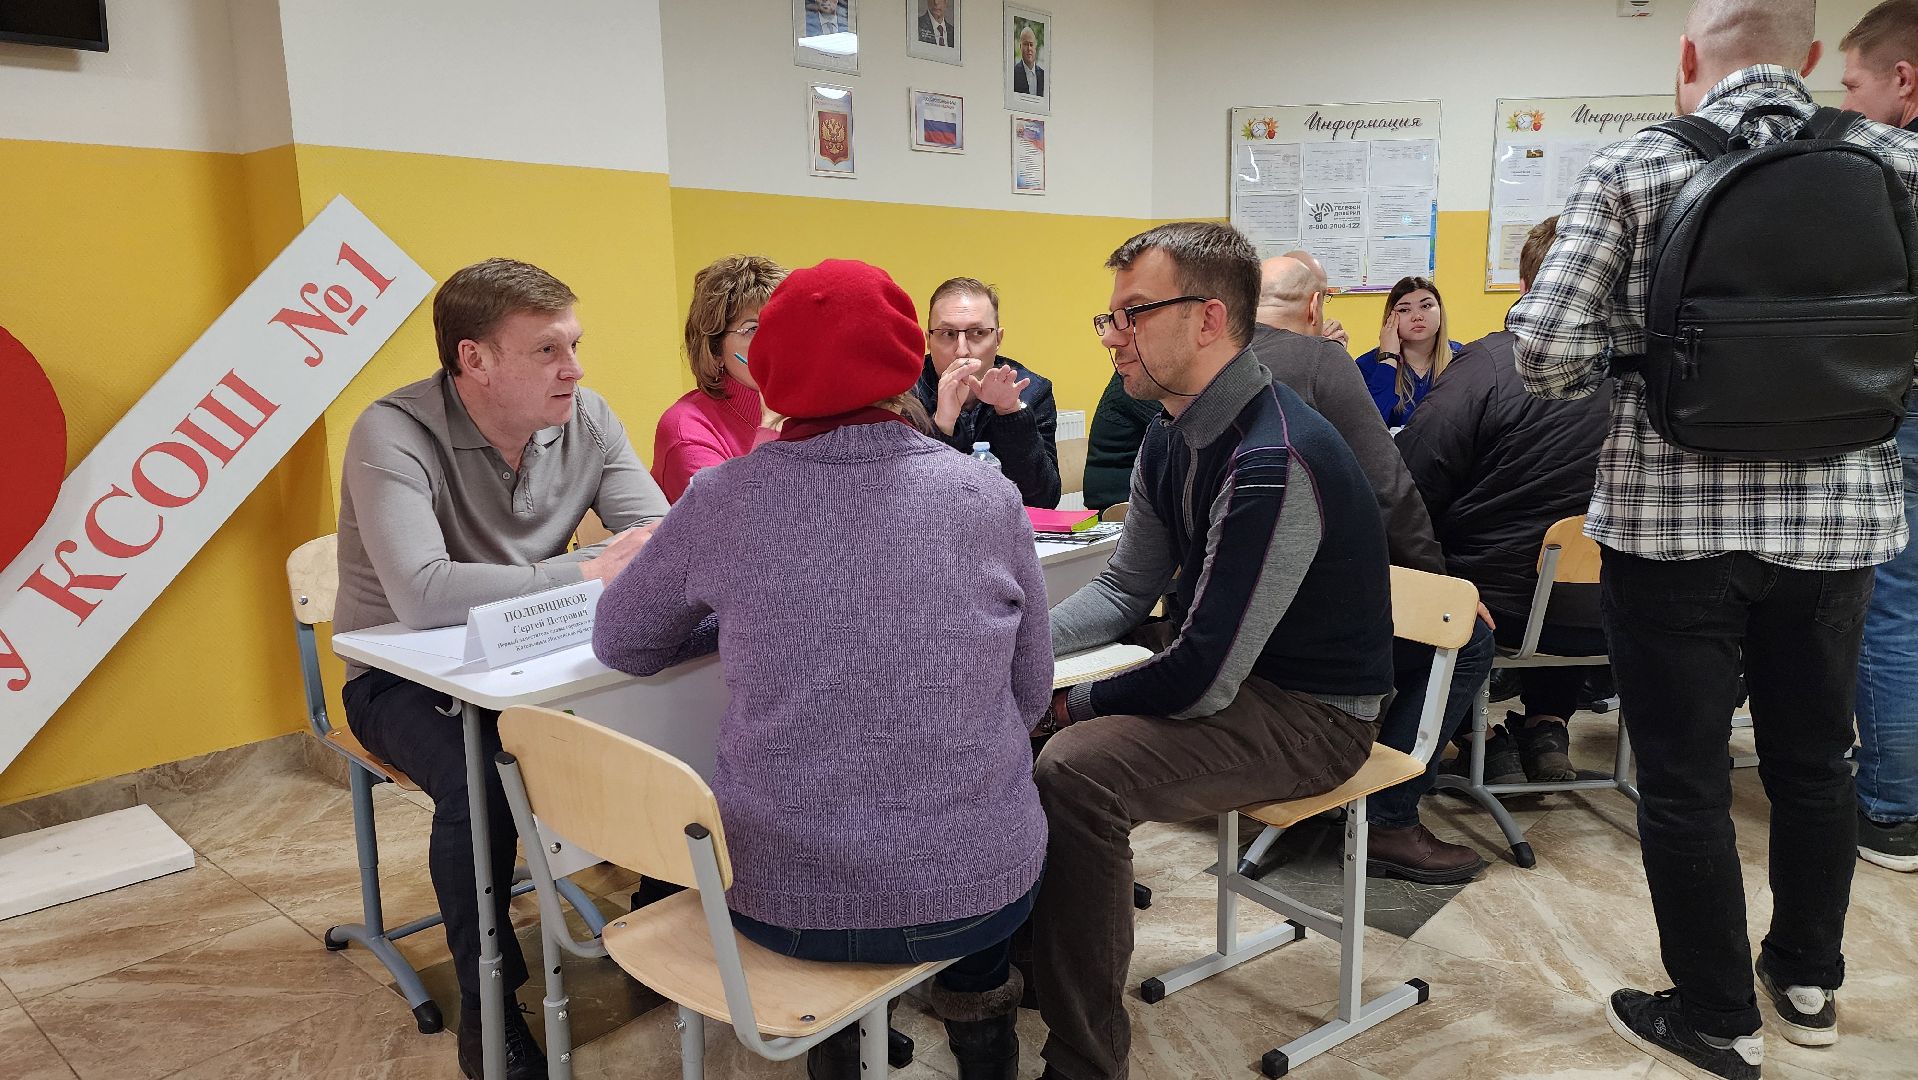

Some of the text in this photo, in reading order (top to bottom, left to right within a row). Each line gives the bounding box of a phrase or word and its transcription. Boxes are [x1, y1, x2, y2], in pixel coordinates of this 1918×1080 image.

[1304, 111, 1422, 140] Информация
[17, 367, 281, 628] КСОШ
[504, 593, 588, 623] ПОЛЕВЩИКОВ
[513, 609, 589, 634] Сергей Петрович
